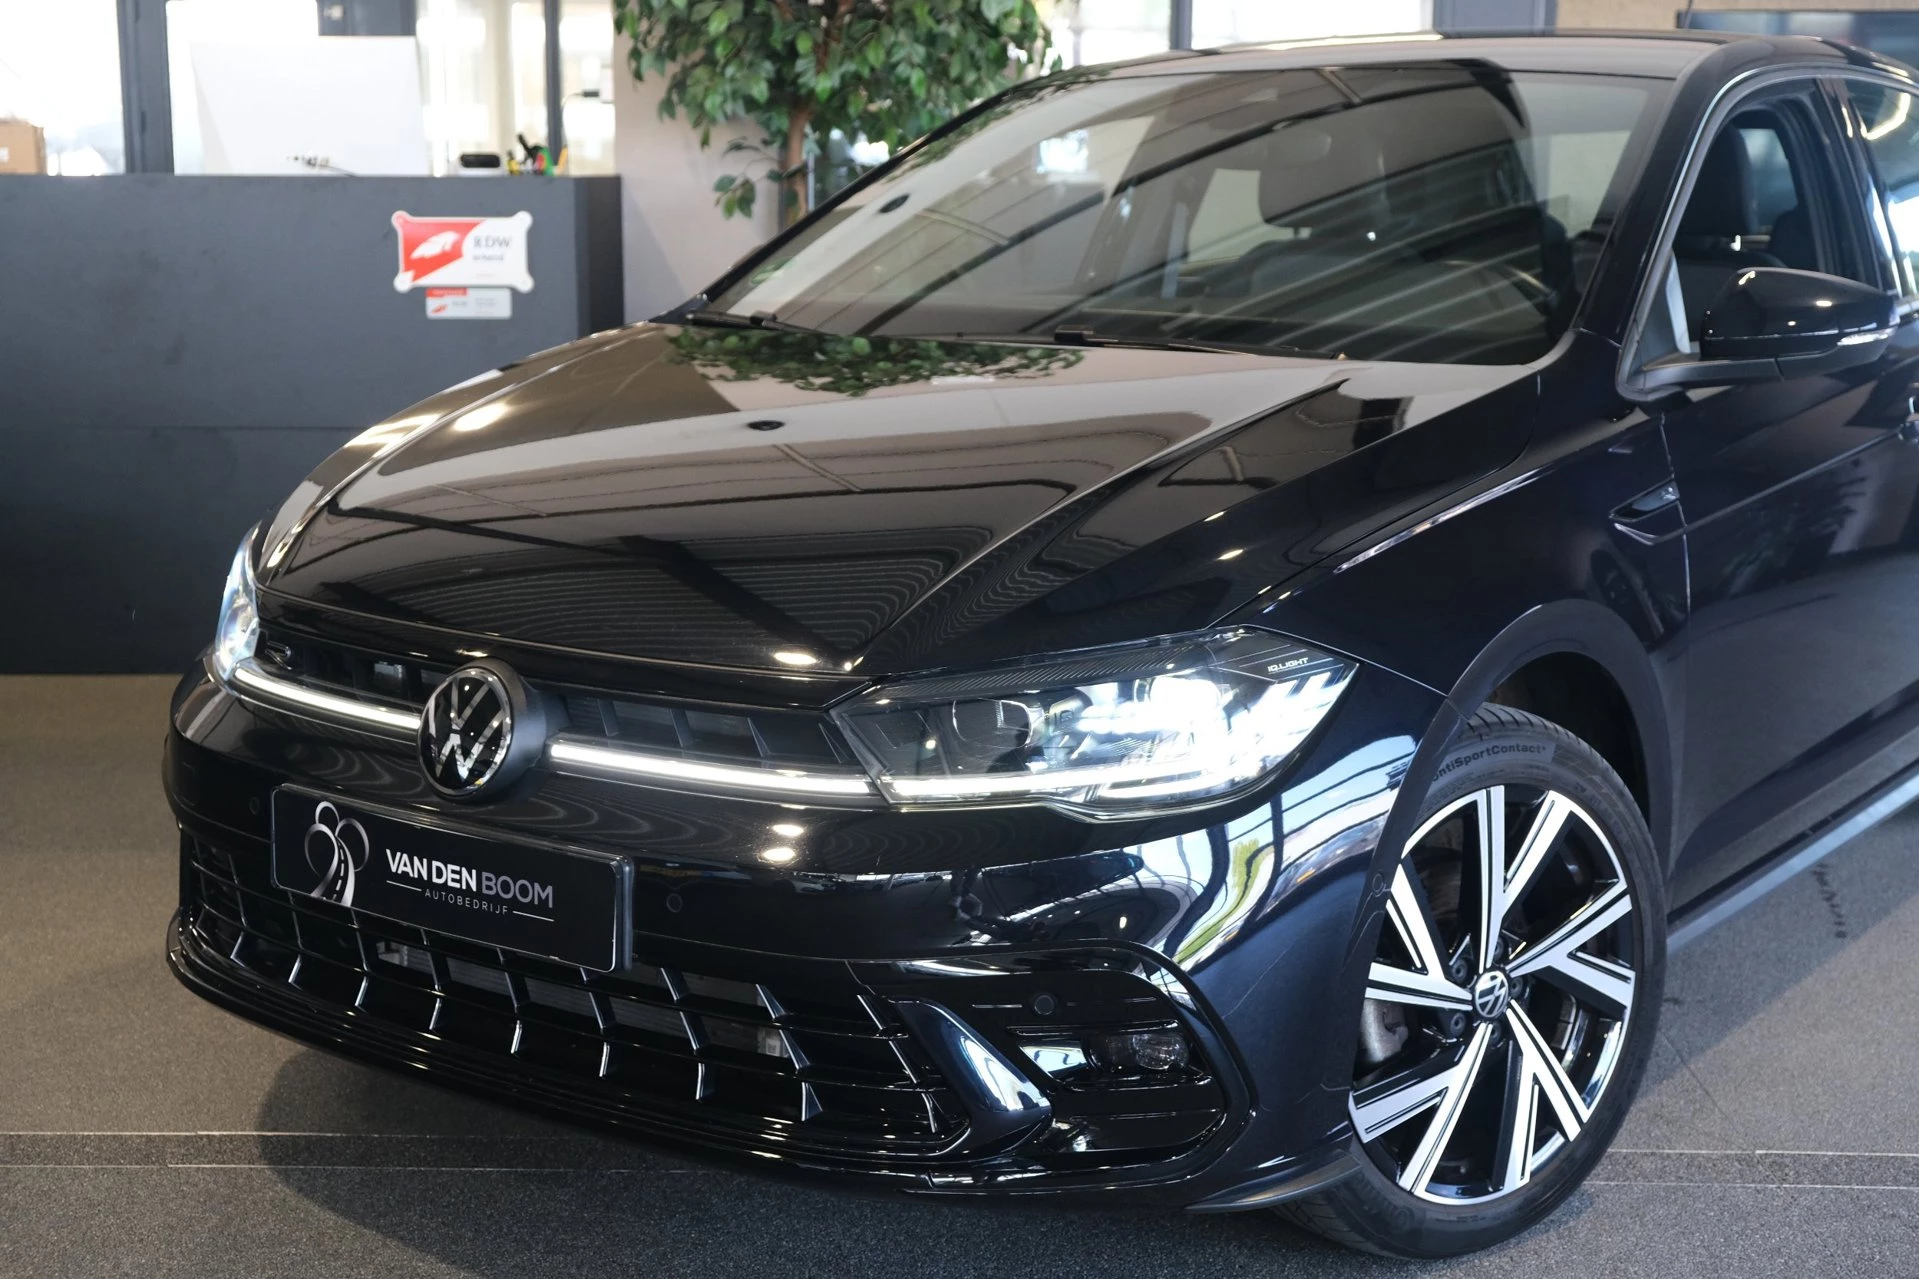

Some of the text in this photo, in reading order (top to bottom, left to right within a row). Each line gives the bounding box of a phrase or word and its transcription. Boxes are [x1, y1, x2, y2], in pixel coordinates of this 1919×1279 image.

[1267, 657, 1309, 673] IQ.LIGHT
[1431, 742, 1543, 781] ontiSportContact
[386, 848, 553, 908] VAN DEN BOOM
[424, 888, 509, 915] AUTOBEDRIJF
